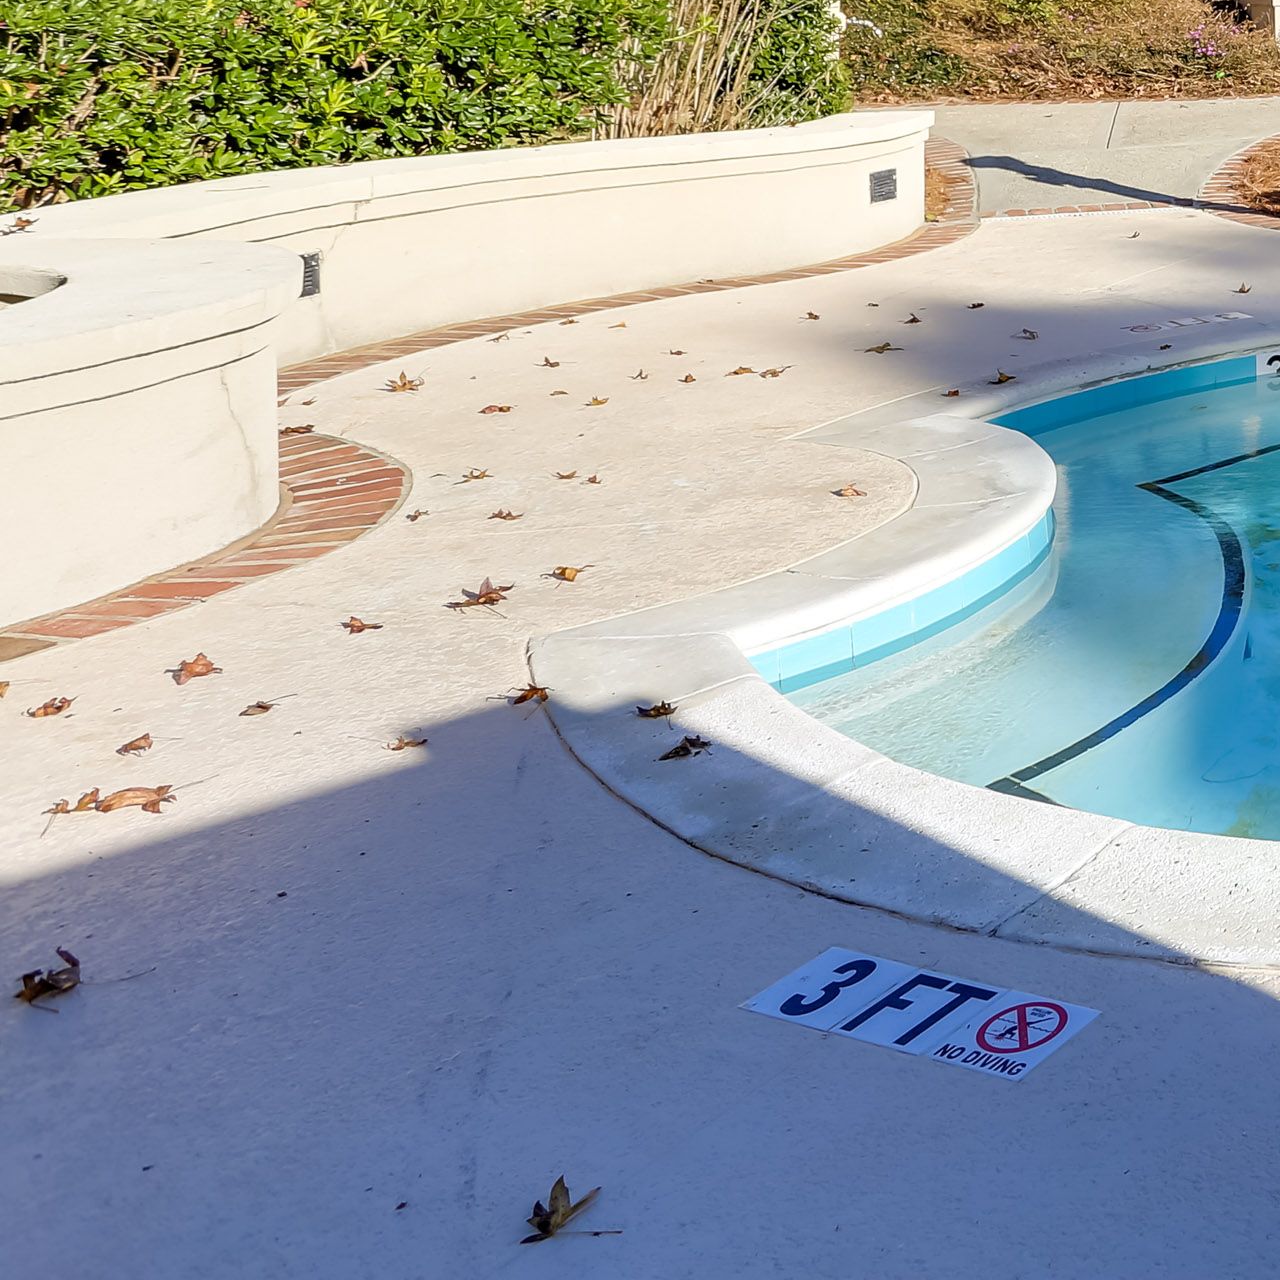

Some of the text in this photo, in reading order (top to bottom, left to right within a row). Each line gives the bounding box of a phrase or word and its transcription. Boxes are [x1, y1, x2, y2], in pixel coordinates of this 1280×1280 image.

[779, 958, 999, 1047] 3 FT
[933, 1043, 1028, 1076] NO DIVING
